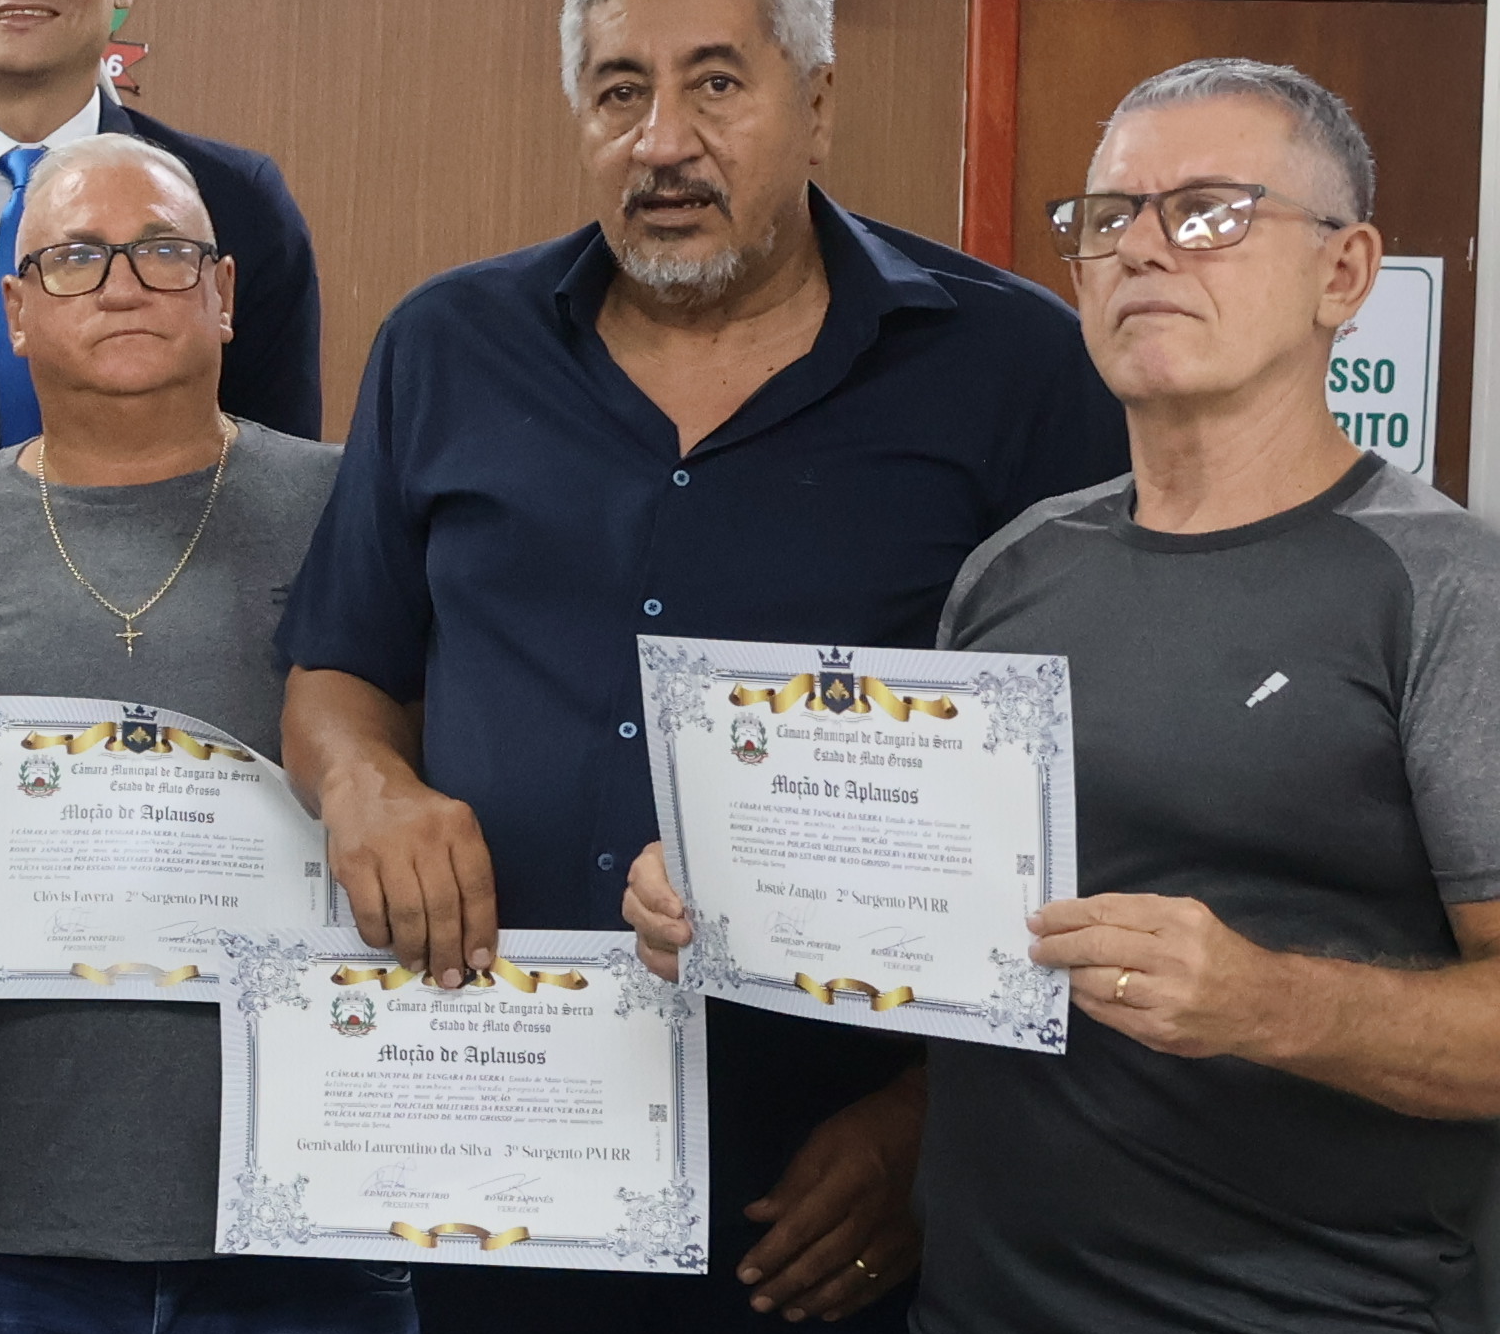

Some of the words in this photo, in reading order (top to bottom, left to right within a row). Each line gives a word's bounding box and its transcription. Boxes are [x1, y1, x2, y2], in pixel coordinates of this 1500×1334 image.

[770, 773, 820, 800] Moção
[823, 779, 841, 799] de
[844, 779, 919, 805] Aplausos
[59, 803, 113, 824] Moção
[118, 804, 136, 820] de
[140, 804, 215, 824] Aplausos
[33, 890, 72, 903] Clóvis
[141, 891, 197, 906] Sargento
[199, 893, 219, 907] PM
[221, 895, 239, 908] RR
[755, 878, 786, 896] Josué
[851, 890, 906, 909] Sargento
[907, 895, 928, 912] PM
[930, 897, 949, 914] RR
[377, 1043, 435, 1067] Moção
[439, 1045, 459, 1063] de
[463, 1045, 547, 1067] Aplausos
[296, 1138, 362, 1152] Genivaldo
[364, 1139, 438, 1155] Laurentino
[439, 1142, 456, 1156] da
[459, 1143, 492, 1157] Silva
[522, 1145, 583, 1162] Sargento
[586, 1147, 608, 1161] PM
[611, 1147, 631, 1161] RR
